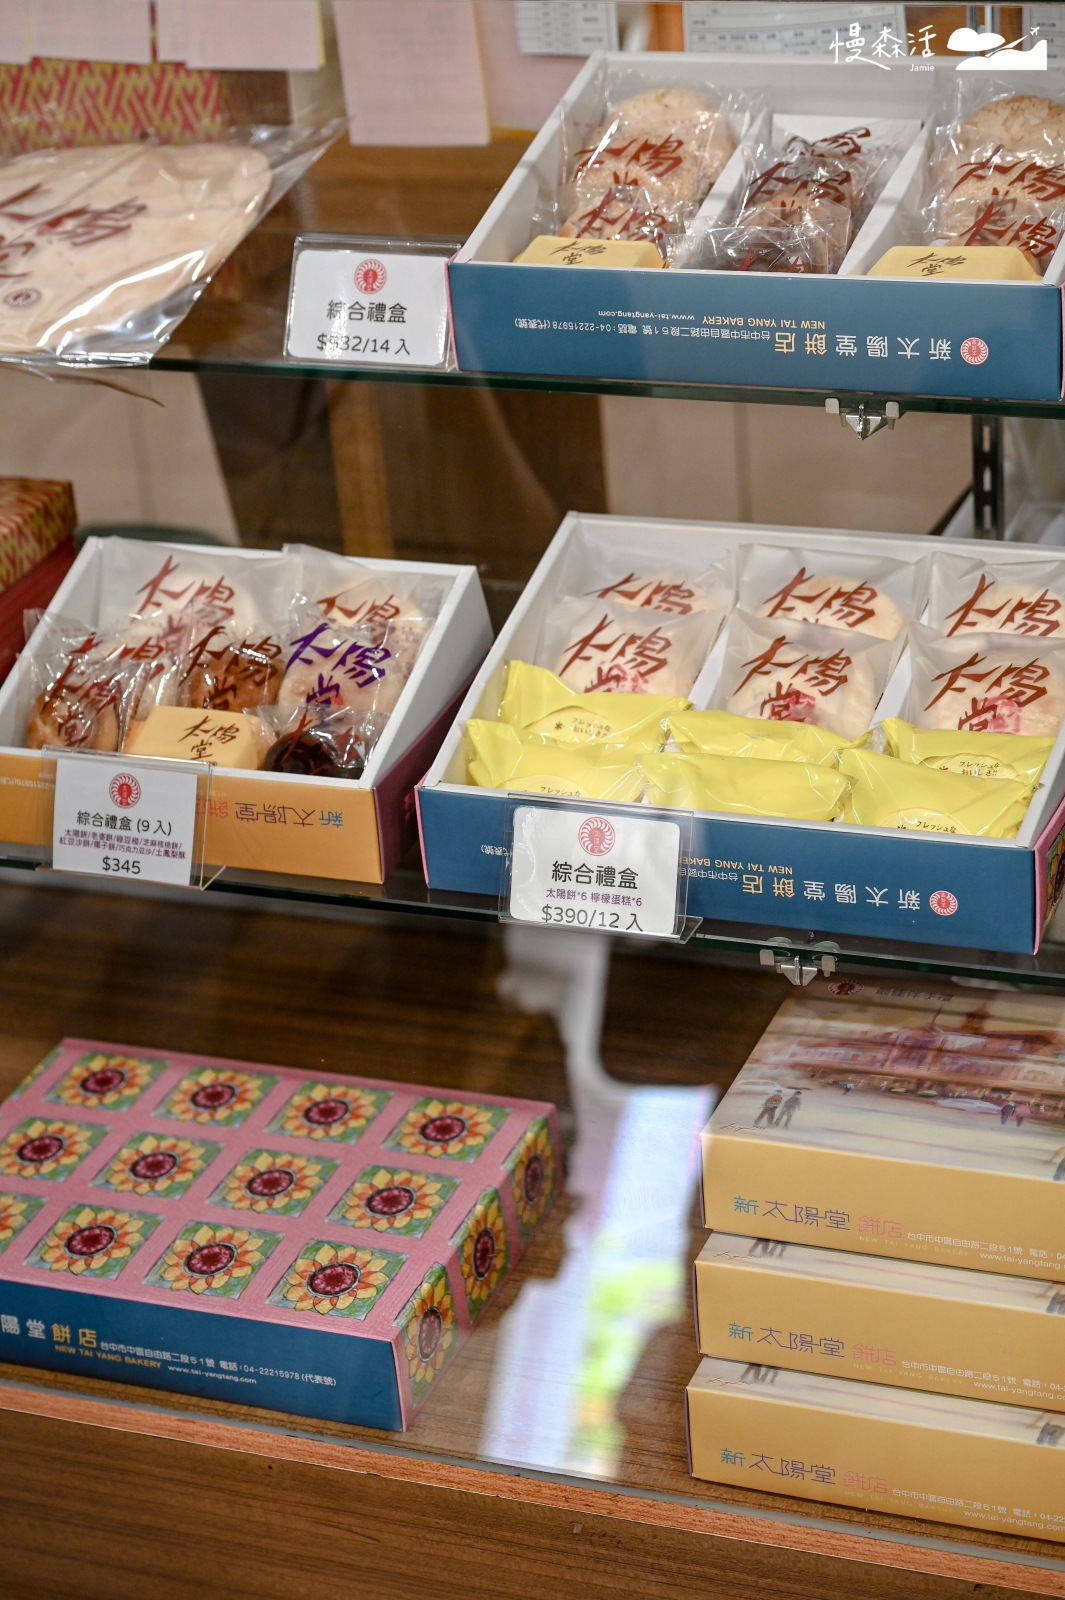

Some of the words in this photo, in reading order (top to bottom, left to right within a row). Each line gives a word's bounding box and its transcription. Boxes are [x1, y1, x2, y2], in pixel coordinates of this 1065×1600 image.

[326, 300, 407, 323] 綜合禮盒
[598, 310, 696, 321] www.tai-yangtang.com
[701, 315, 744, 326] BAKERY
[747, 318, 777, 327] YANG
[780, 319, 798, 329] TAI
[800, 320, 826, 330] NEW
[763, 567, 878, 628] 太陽
[944, 573, 1062, 638] 太陽
[286, 622, 392, 689] 太陽
[559, 613, 673, 678] 太陽
[732, 635, 853, 697] 太陽
[924, 653, 1051, 712] 太陽
[178, 715, 240, 744] 太陽
[190, 739, 213, 759] 堂
[76, 810, 132, 831] 綜合禮盒
[136, 819, 150, 833] (9
[102, 856, 141, 875] $345
[679, 856, 711, 867] BAKE
[715, 860, 744, 870] YANG
[748, 863, 764, 872] TAI
[768, 865, 793, 875] NEW
[551, 860, 639, 890] 綜合禮盒
[541, 904, 620, 928] $390/12
[626, 913, 643, 932] 入
[54, 1345, 76, 1355] NEW
[79, 1348, 93, 1358] TAI
[96, 1351, 121, 1362] YANG
[125, 1356, 161, 1369] BAKERY
[167, 1365, 257, 1384] www.tai-yangtang.com
